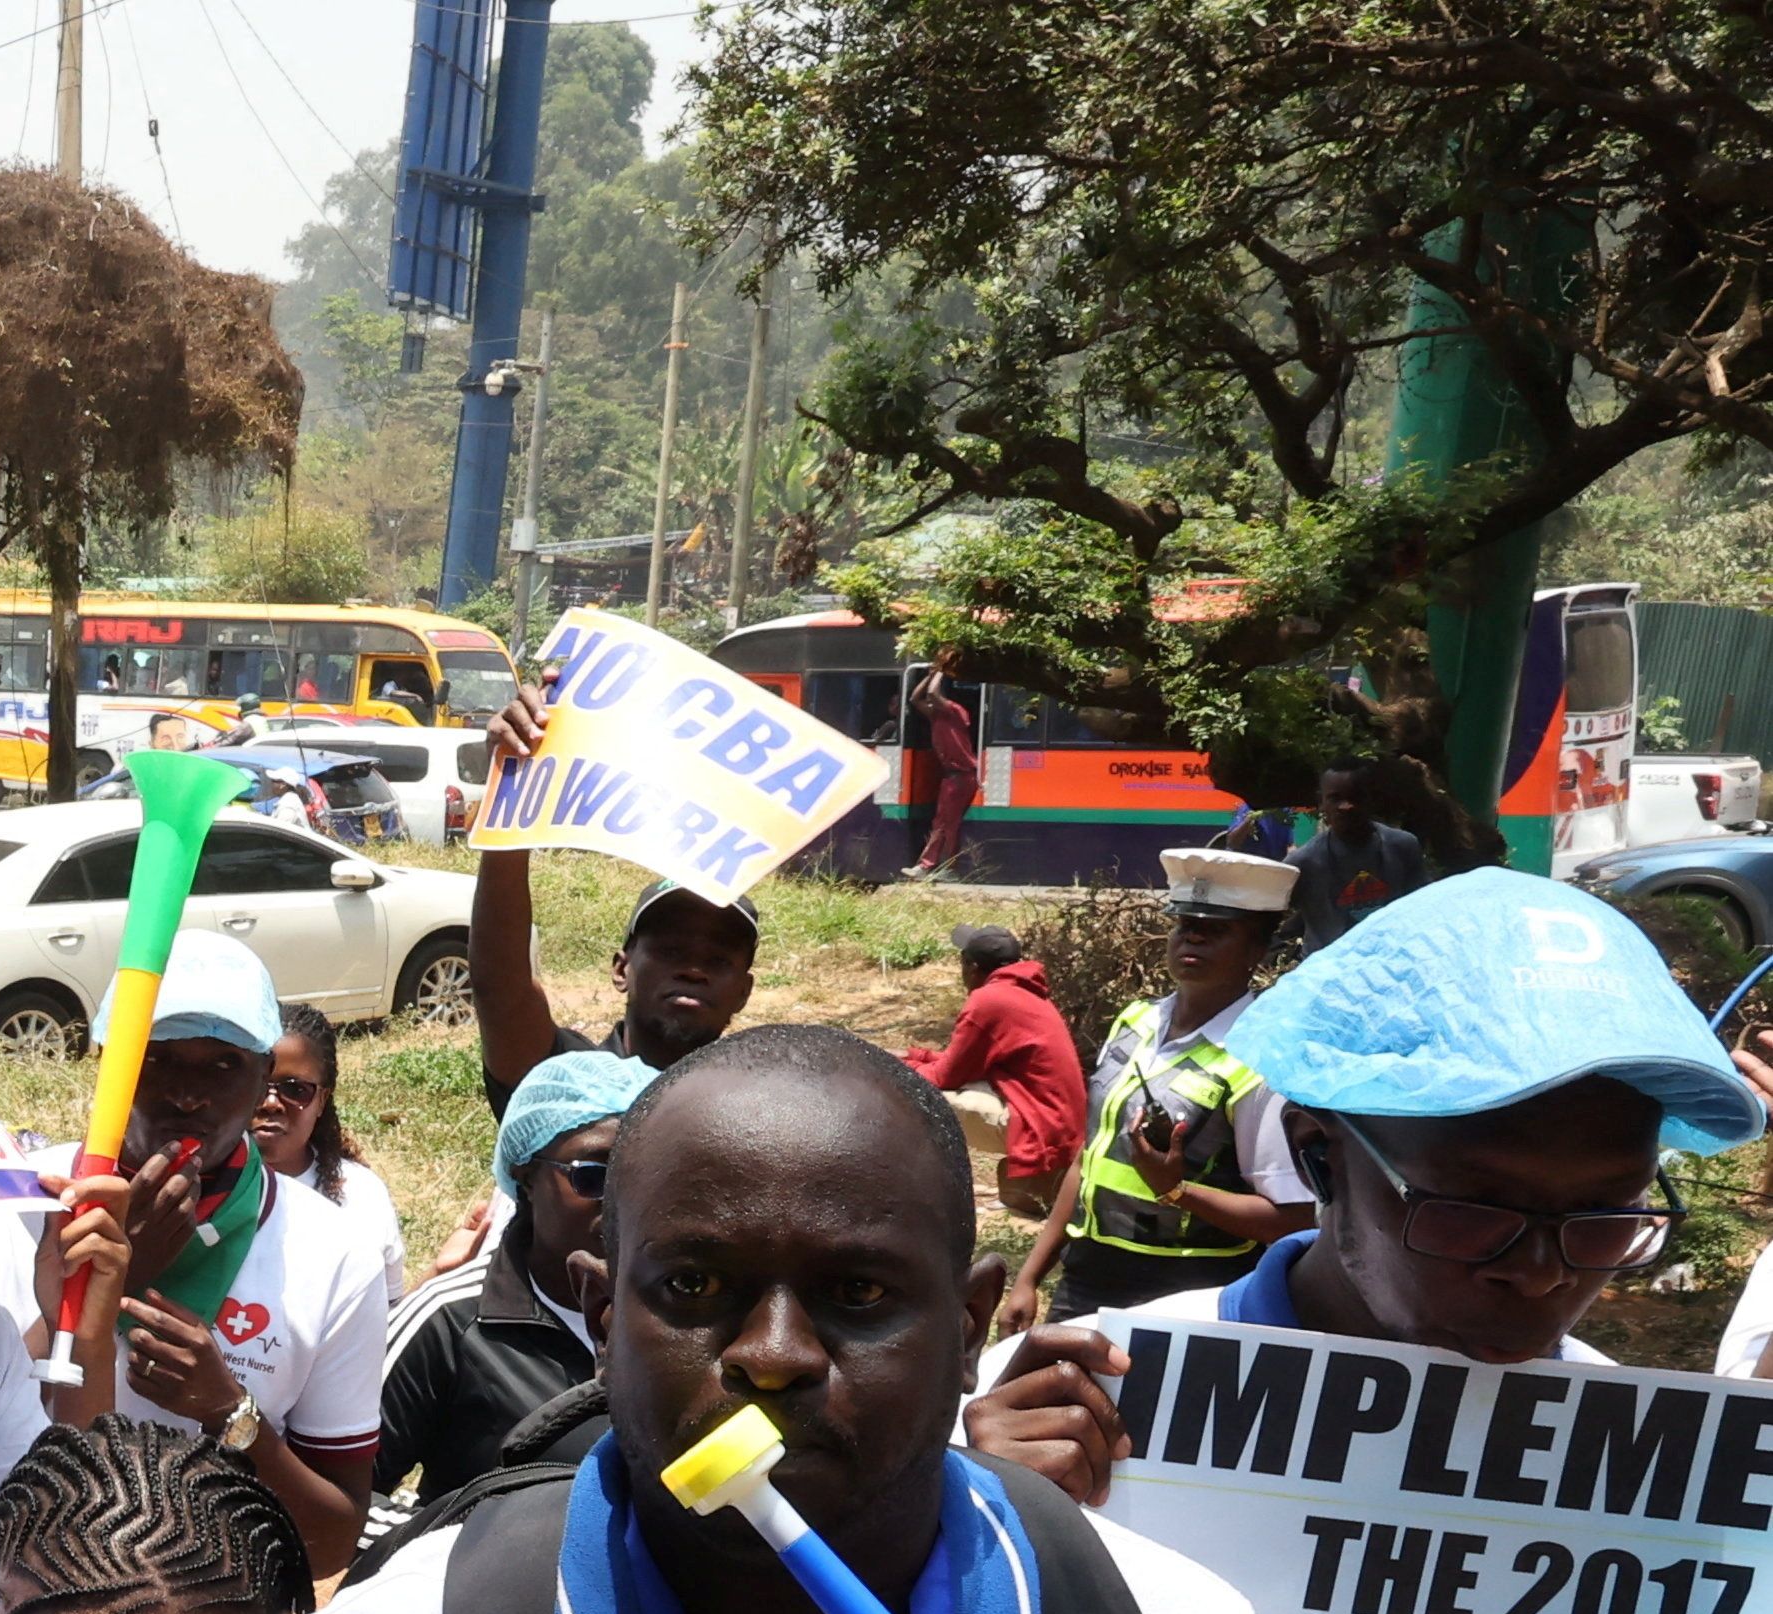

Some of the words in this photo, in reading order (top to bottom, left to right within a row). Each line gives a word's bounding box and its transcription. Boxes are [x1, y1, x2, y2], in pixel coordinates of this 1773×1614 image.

[82, 618, 183, 643] RAJ
[543, 625, 655, 711] NO
[660, 677, 846, 818] CBA
[1108, 760, 1173, 778] OROKISE
[486, 756, 556, 829] NO
[551, 757, 771, 888] WORK
[223, 1351, 246, 1367] West
[247, 1357, 276, 1375] Nurses
